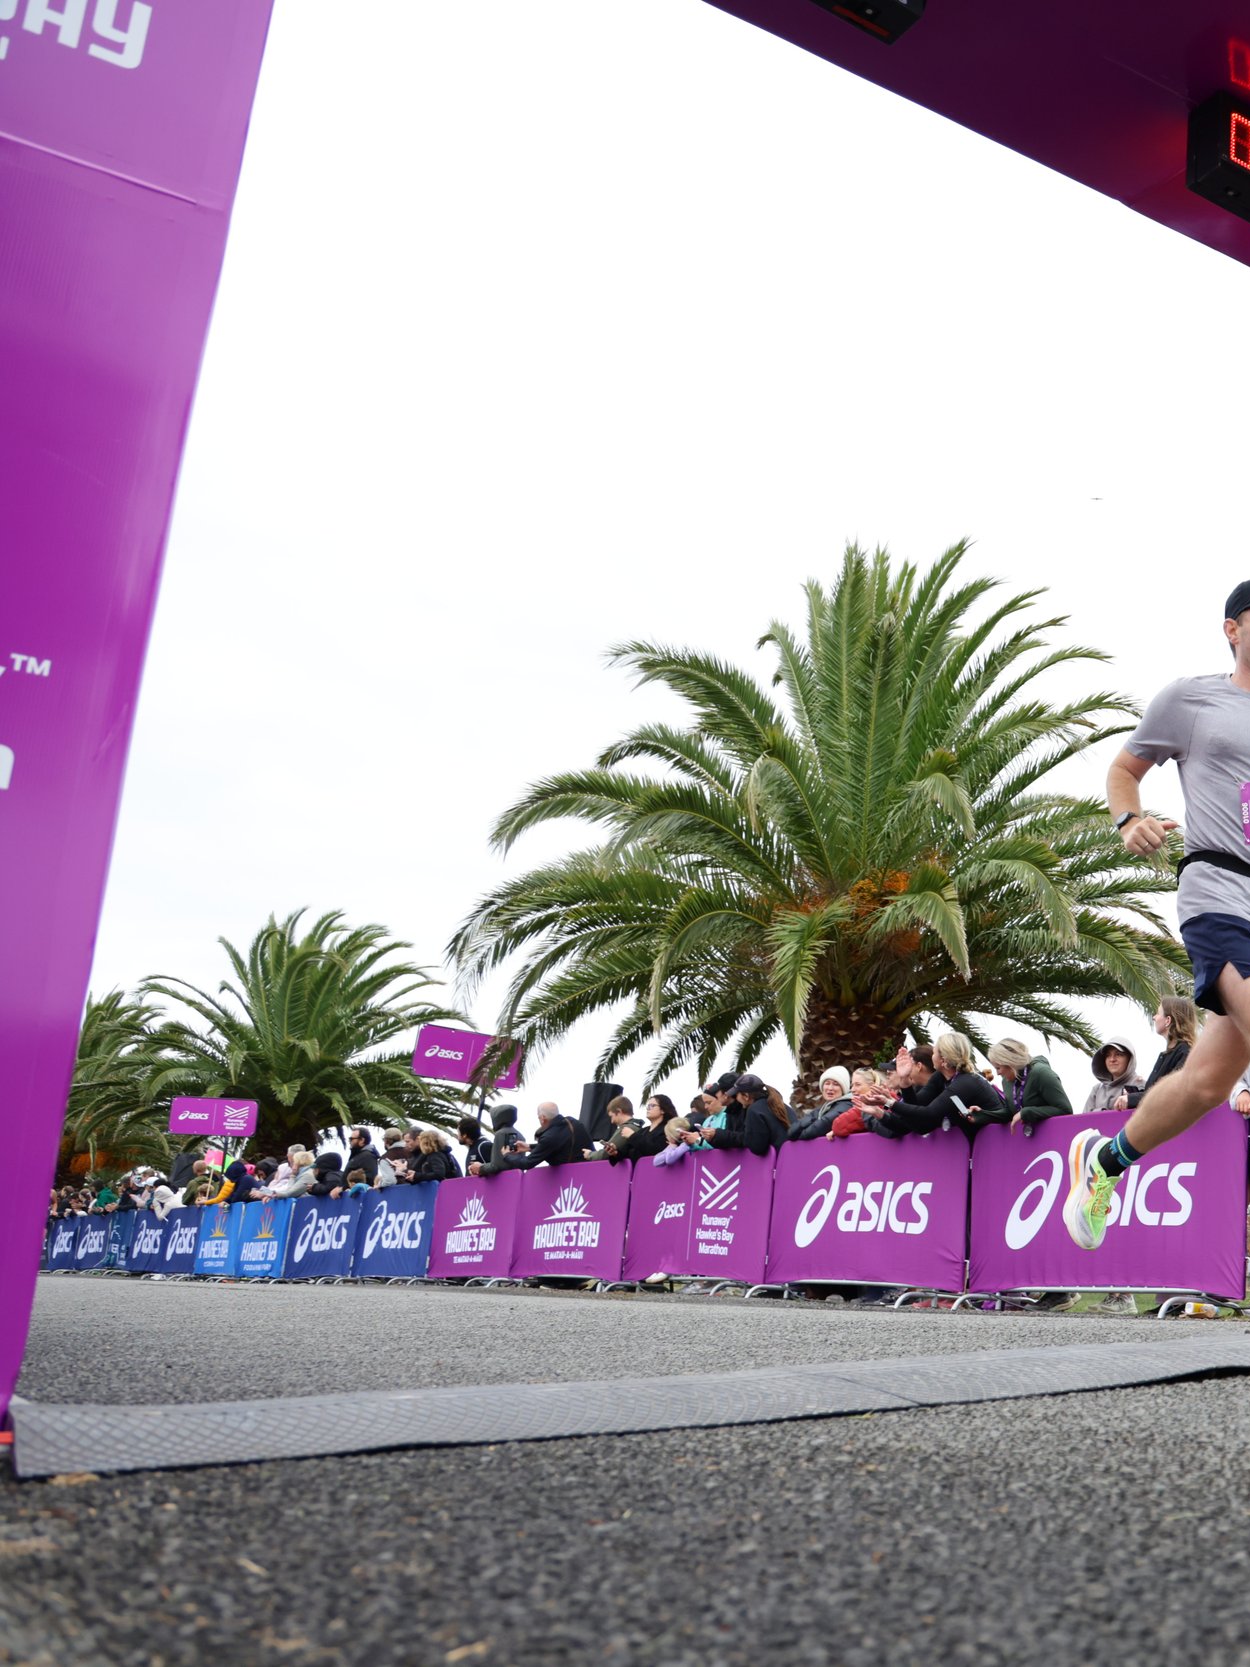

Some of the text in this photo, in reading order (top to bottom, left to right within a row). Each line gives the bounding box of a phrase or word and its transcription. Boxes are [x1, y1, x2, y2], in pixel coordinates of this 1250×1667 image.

[0, 0, 153, 70] AY
[478, 1227, 497, 1251] BAY
[533, 1221, 601, 1250] HAWKE'S BAY
[721, 1228, 735, 1245] Bay
